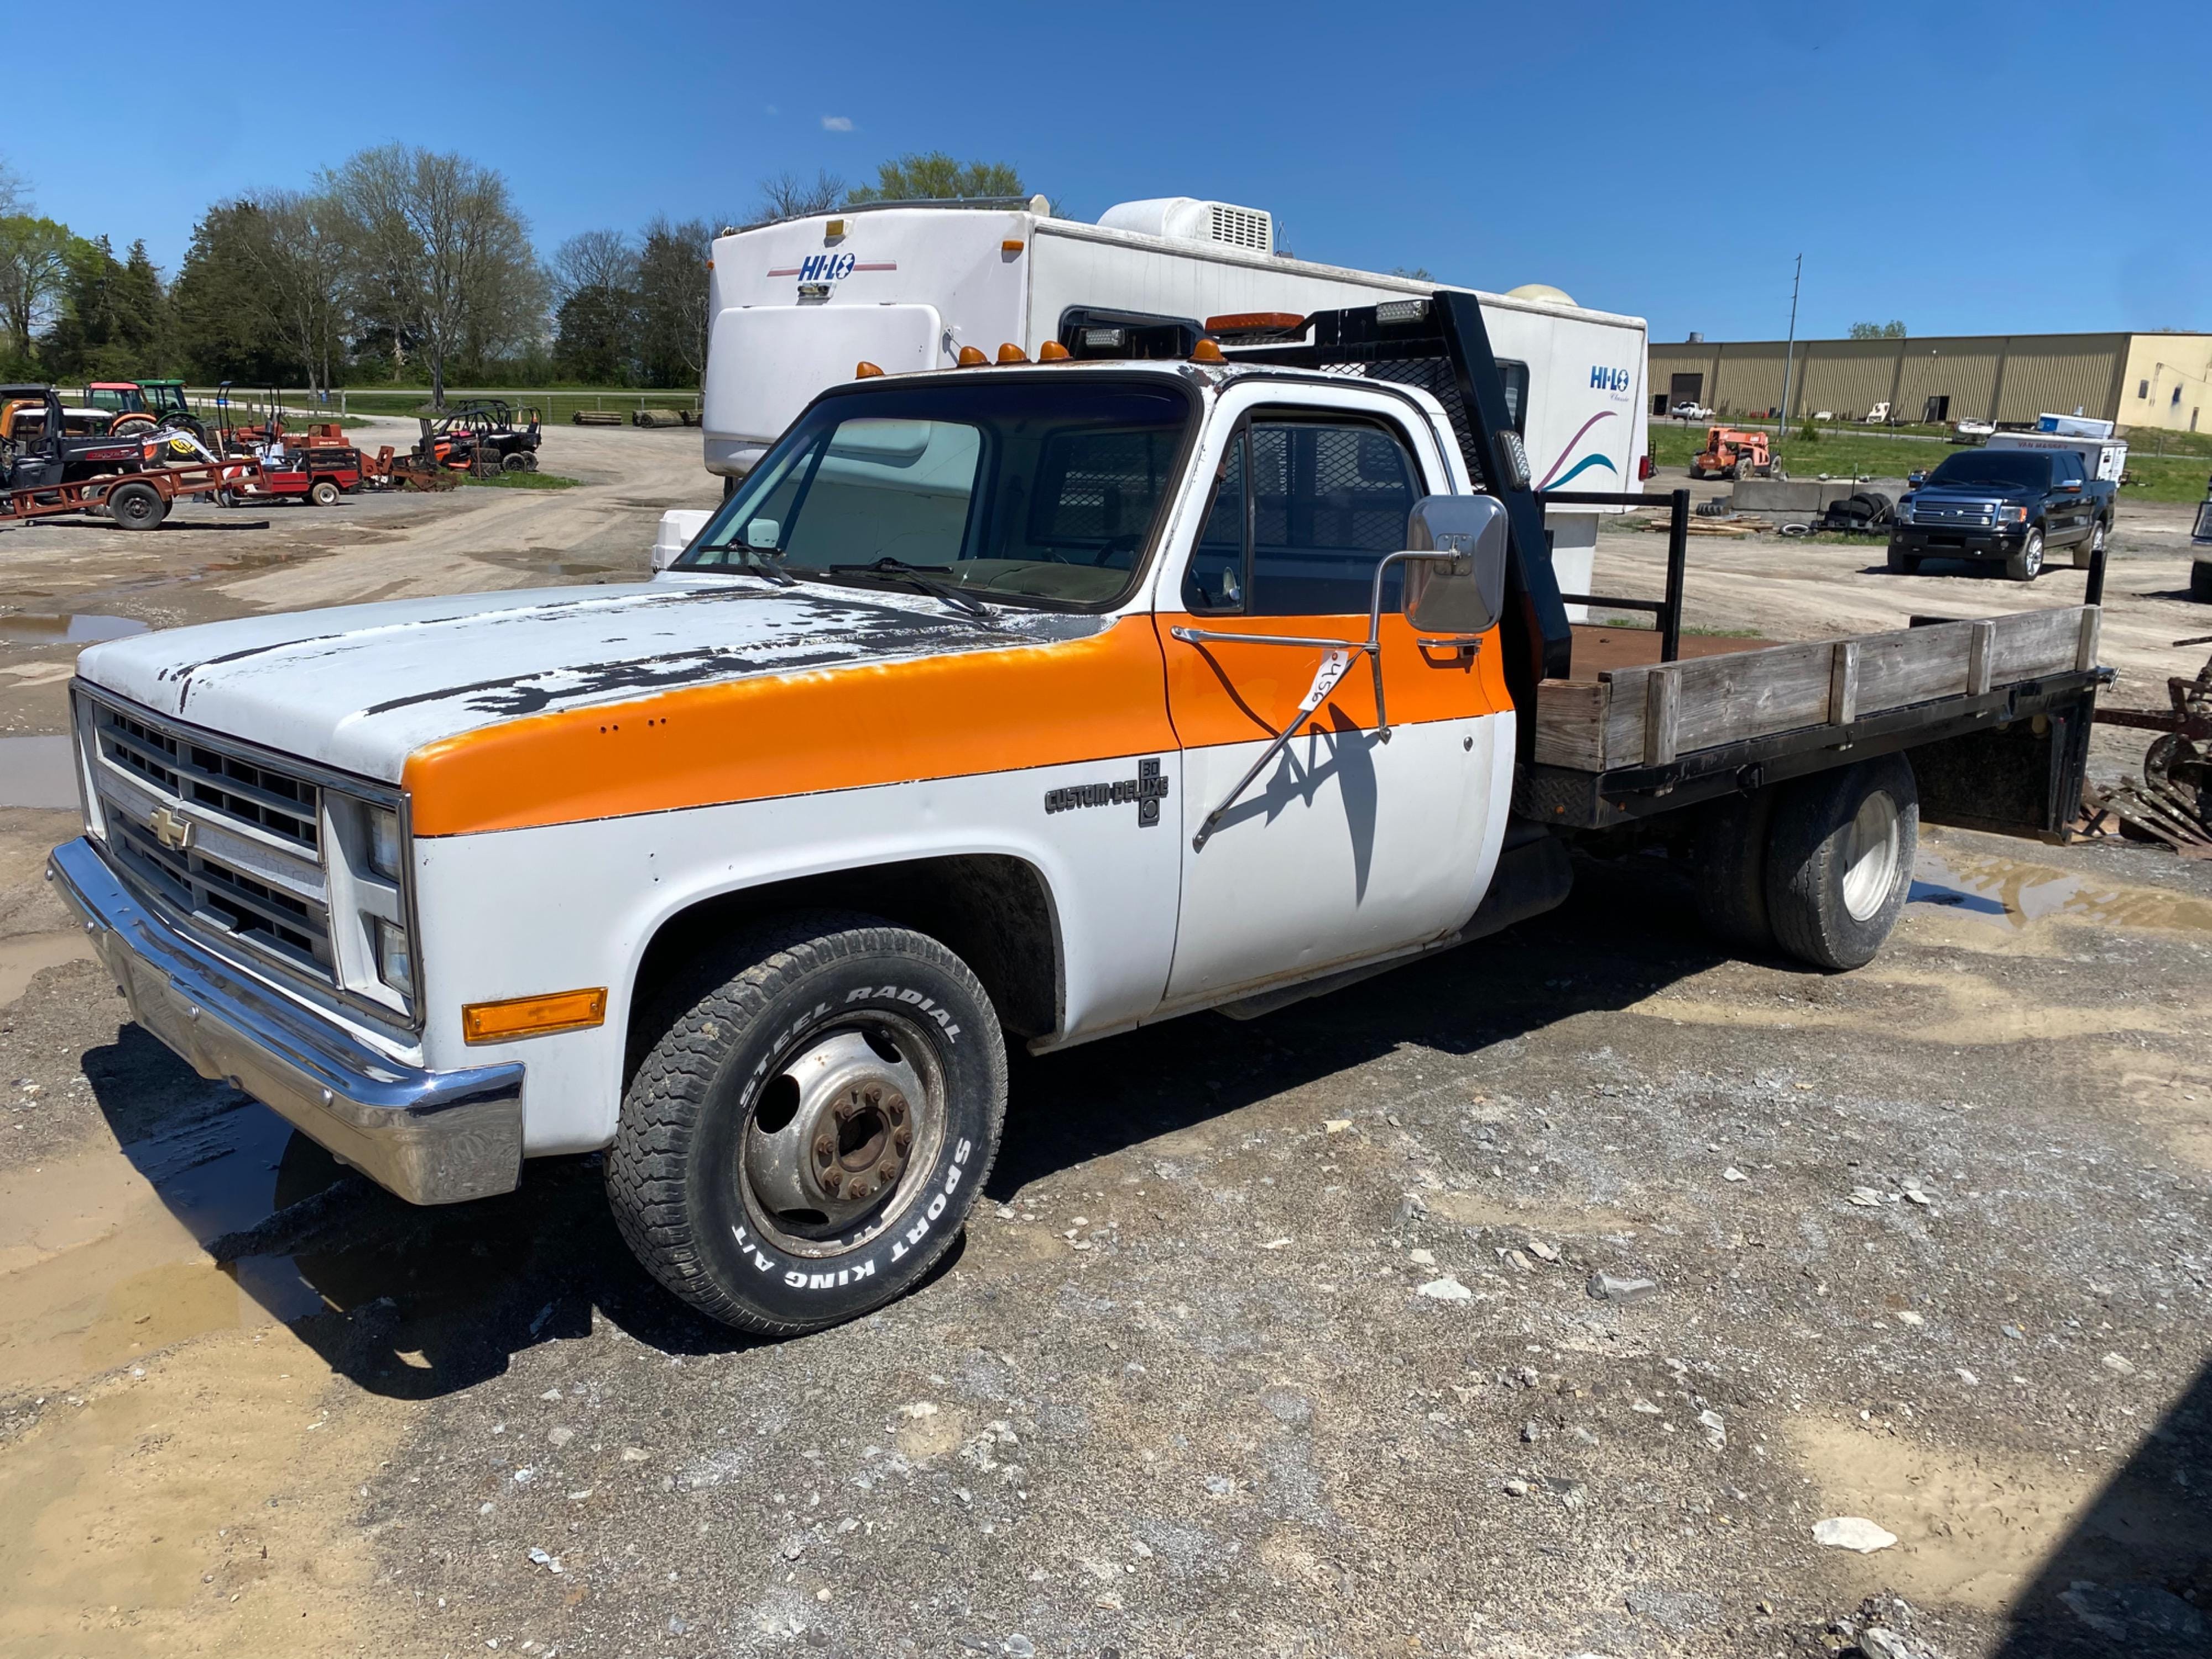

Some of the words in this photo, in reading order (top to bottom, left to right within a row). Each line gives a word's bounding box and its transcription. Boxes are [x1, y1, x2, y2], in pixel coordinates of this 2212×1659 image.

[797, 253, 855, 281] HI-LO
[1590, 365, 1629, 392] HI-LO
[1143, 761, 1159, 775] 30
[1045, 782, 1110, 815] CUSTOM
[1113, 776, 1168, 805] DELUXE
[740, 1002, 833, 1108] STEEL
[845, 986, 961, 1044] RADIAL
[891, 1137, 972, 1262] SPORT
[731, 1225, 775, 1272] A/T
[784, 1259, 876, 1290] KING
